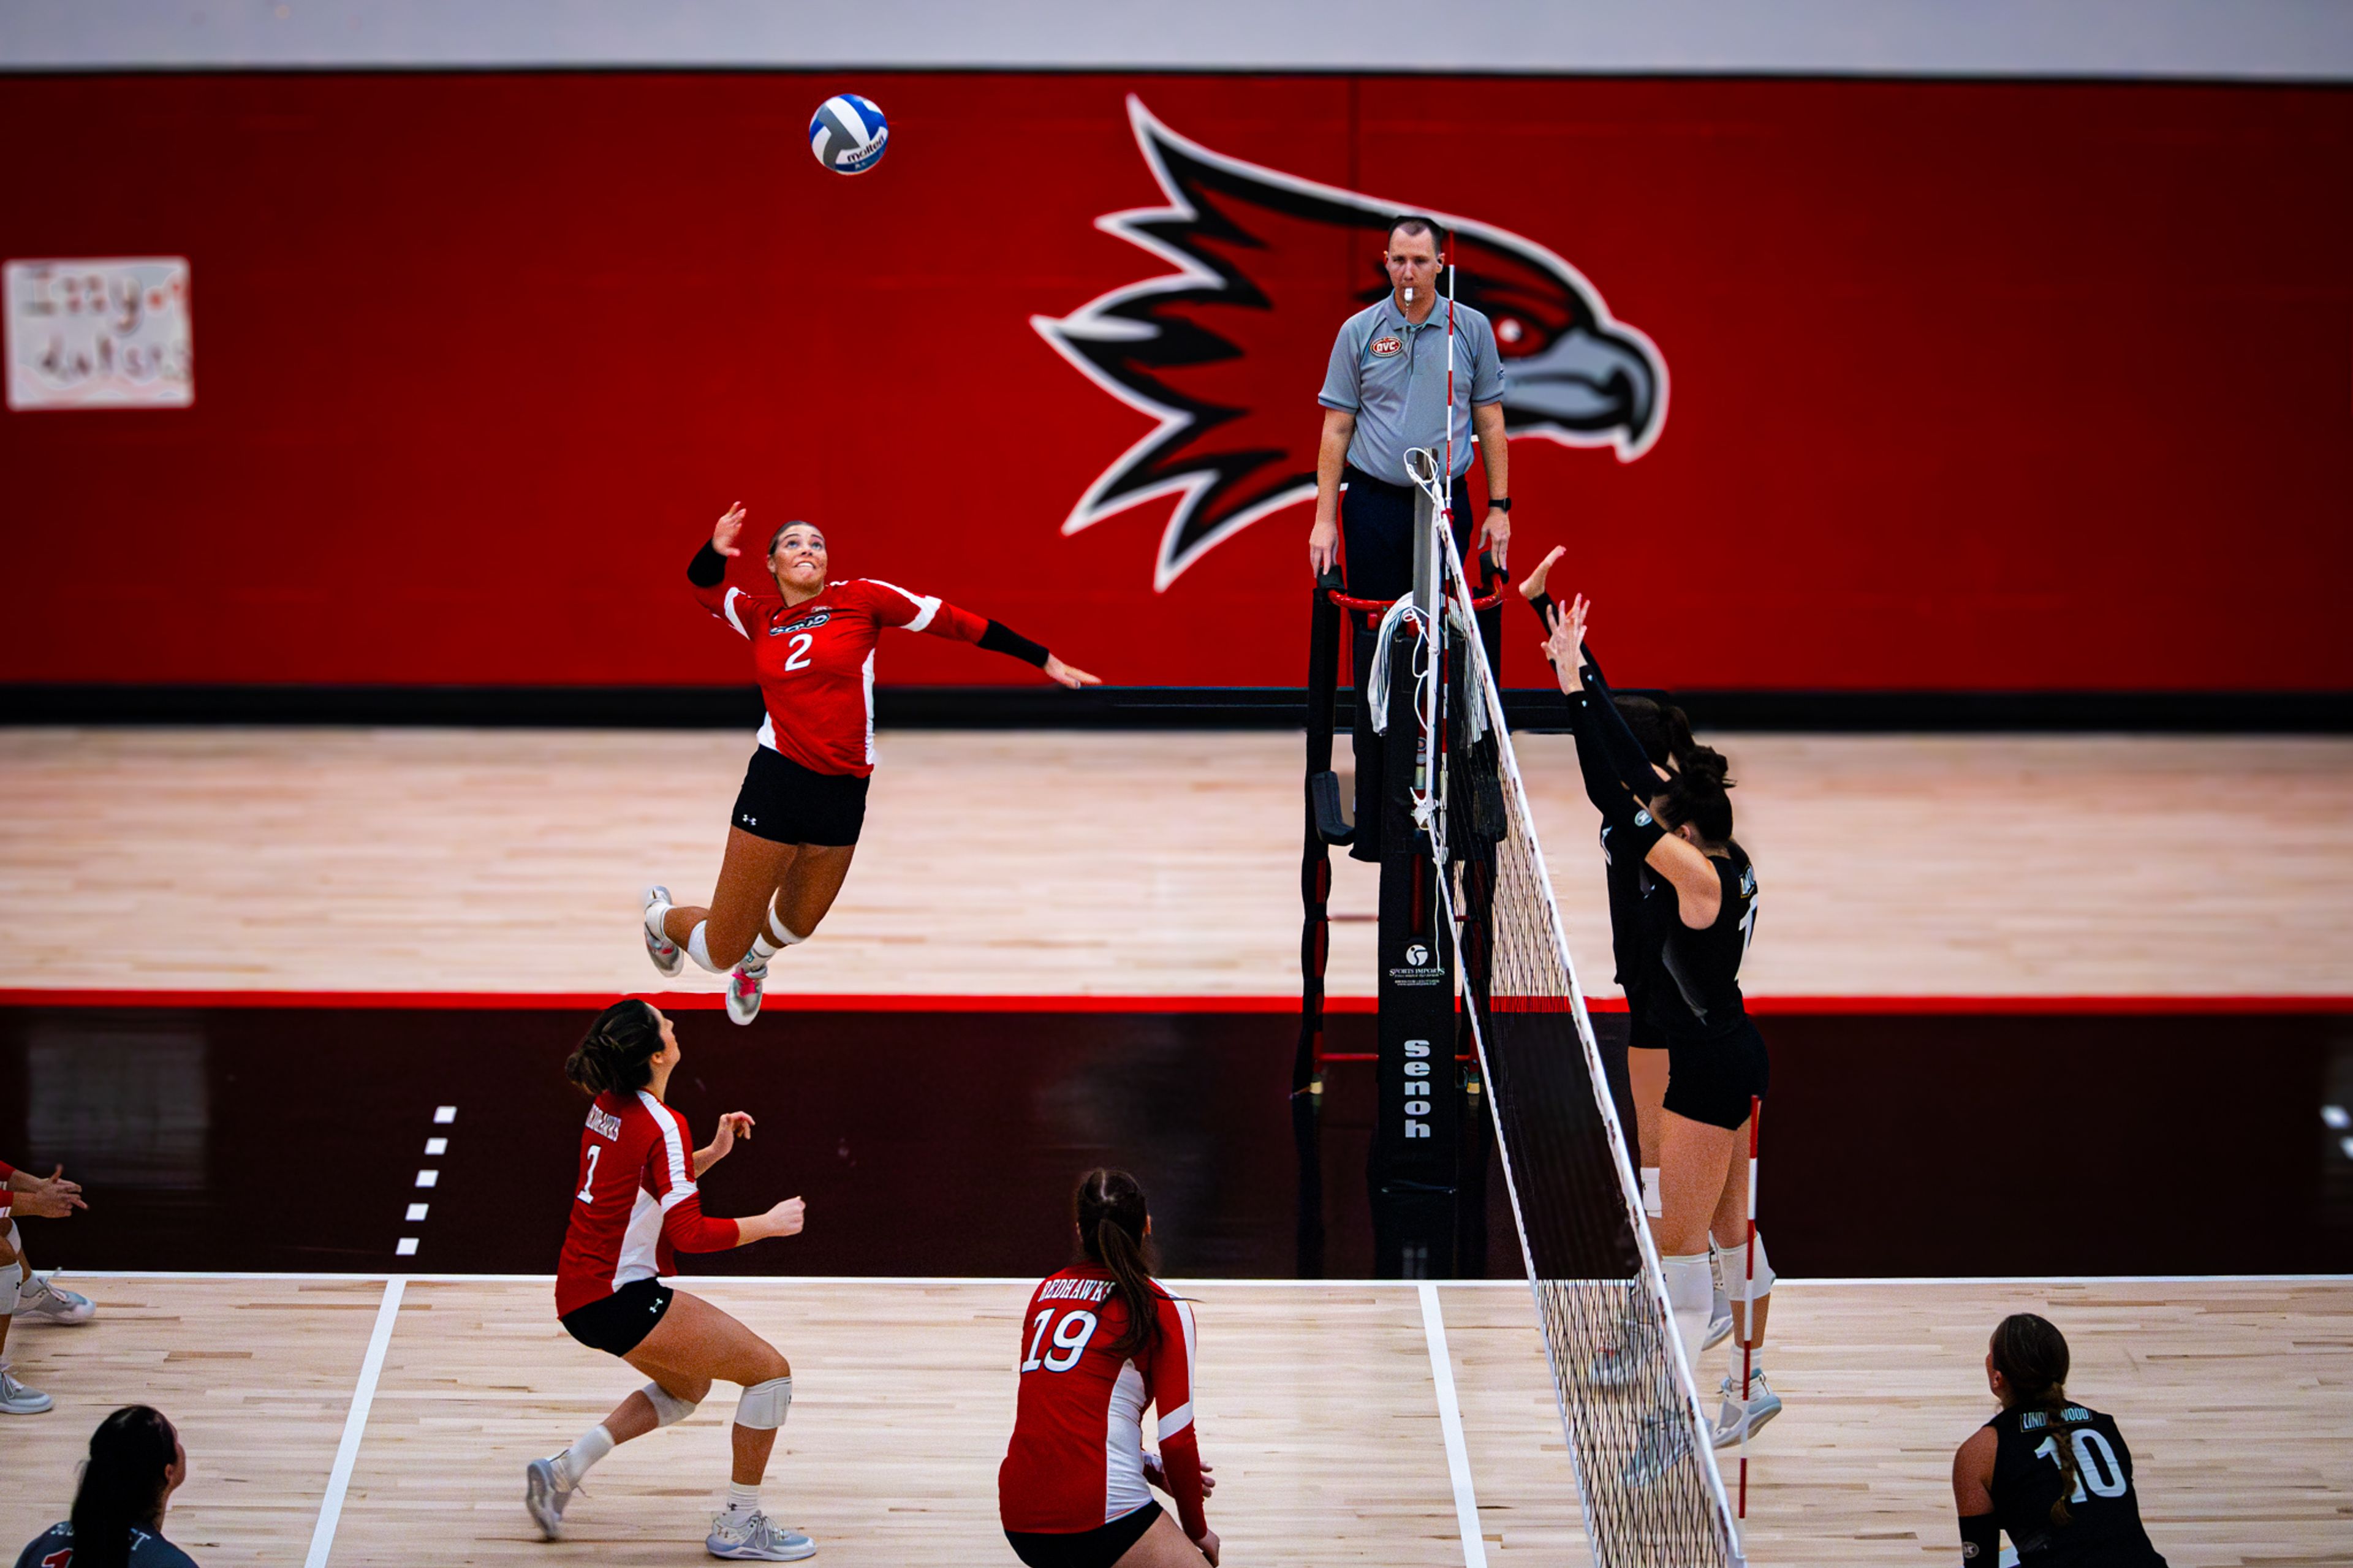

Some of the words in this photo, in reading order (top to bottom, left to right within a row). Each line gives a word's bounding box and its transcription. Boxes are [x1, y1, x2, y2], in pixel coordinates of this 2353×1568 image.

[847, 135, 884, 162] molten
[785, 633, 813, 672] 2
[1404, 1040, 1431, 1138] senoh
[577, 1145, 601, 1204] 1
[1021, 1308, 1097, 1372] 19
[2023, 1407, 2089, 1429] LINDWOOD
[2034, 1428, 2127, 1503] 10
